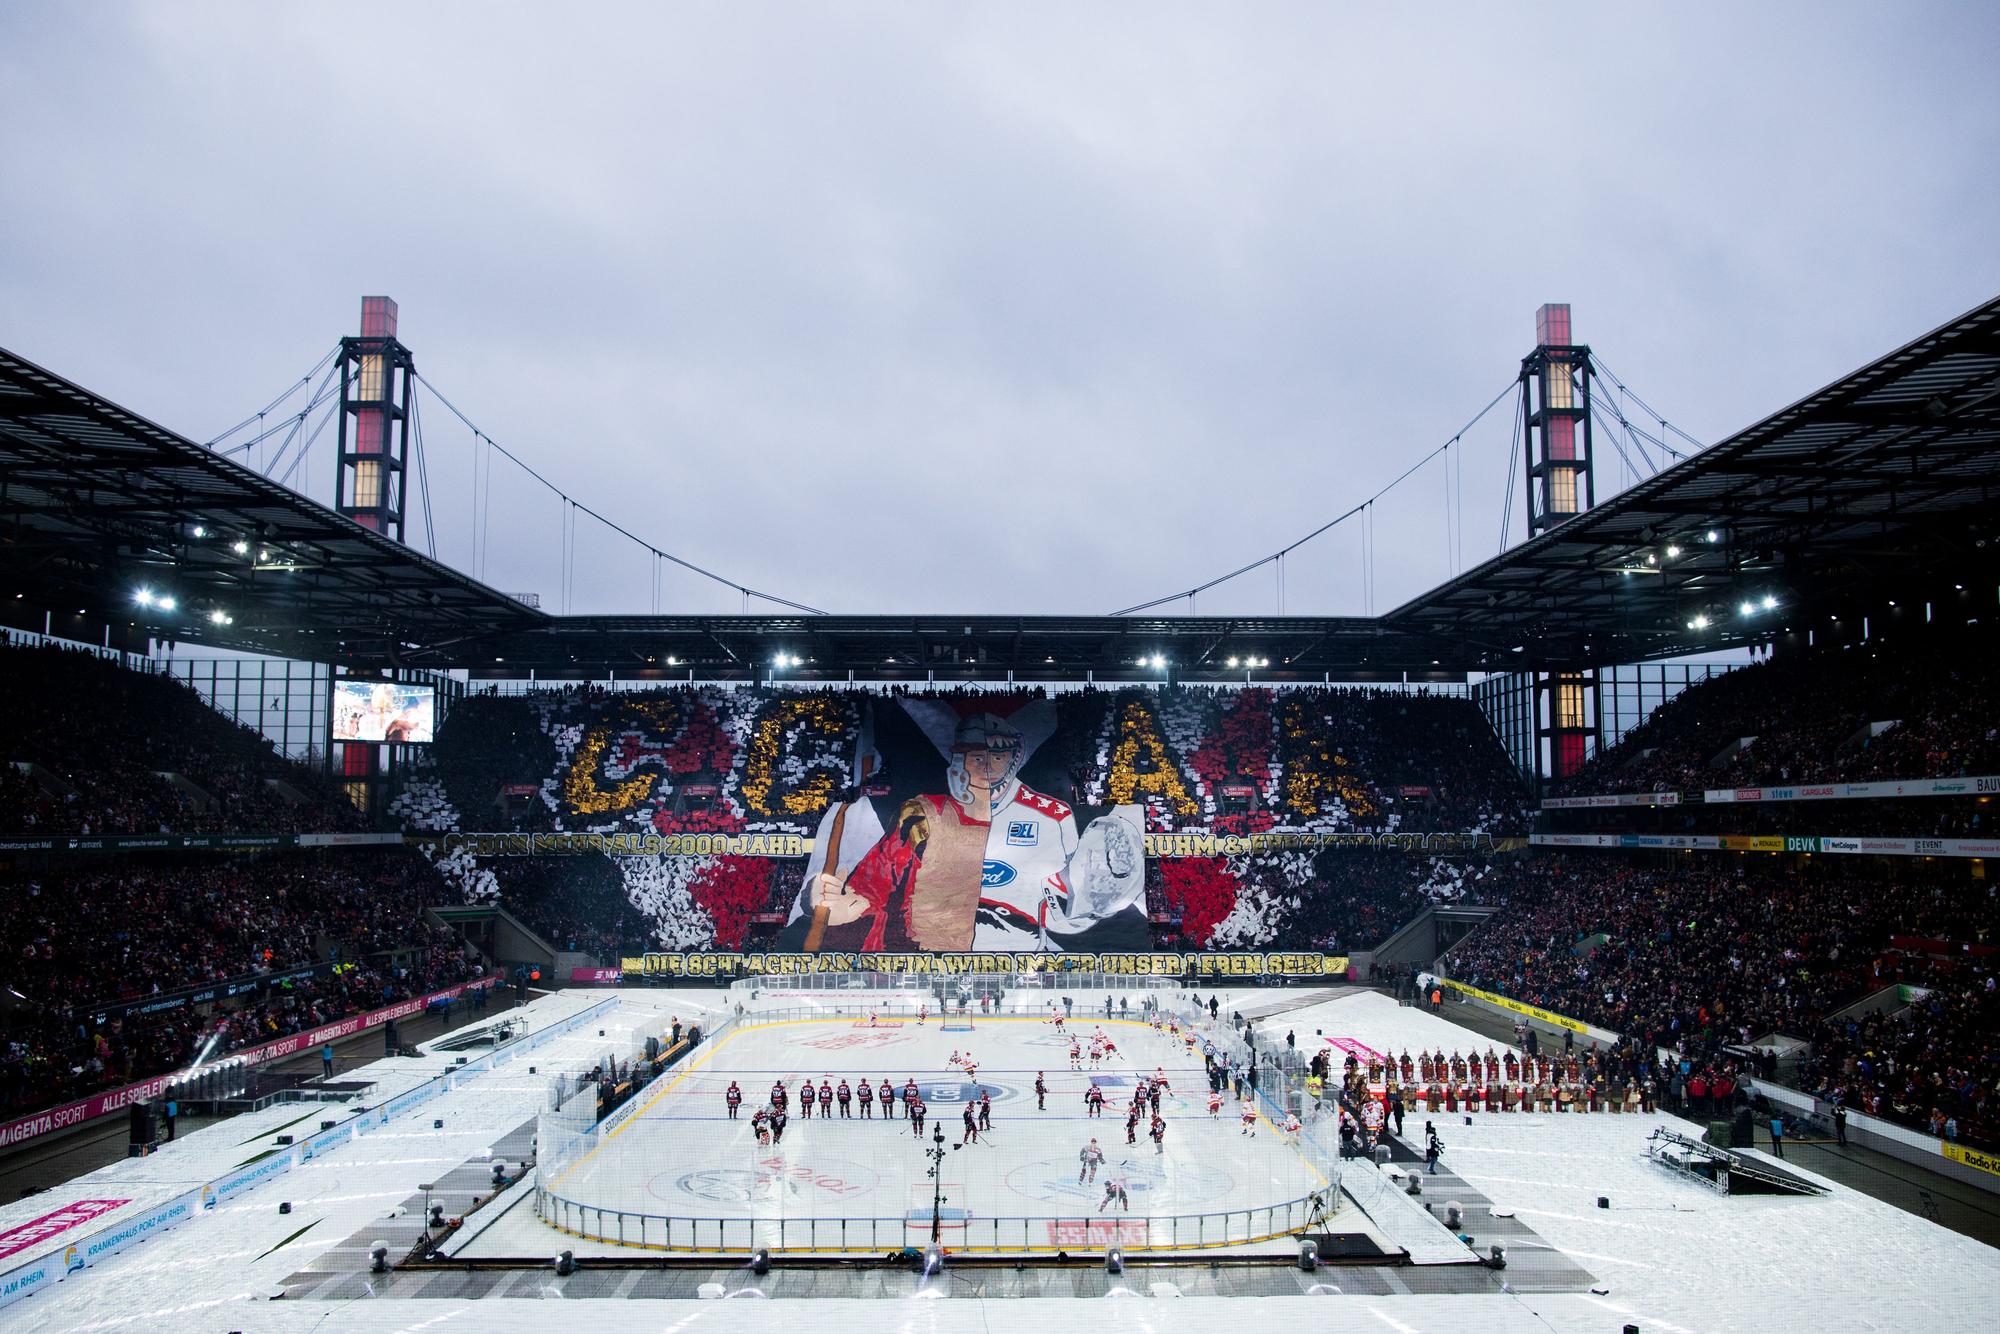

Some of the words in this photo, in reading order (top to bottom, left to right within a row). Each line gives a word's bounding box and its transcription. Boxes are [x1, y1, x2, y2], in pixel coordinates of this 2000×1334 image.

[612, 834, 661, 856] ALS
[665, 834, 728, 856] 2000
[732, 834, 803, 856] JAHR
[1145, 834, 1217, 856] RUHM
[1224, 834, 1244, 856] &
[1788, 838, 1816, 852] DEVK
[1831, 841, 1858, 850] NetCologne
[1922, 840, 1942, 848] EVENT
[644, 954, 684, 976] DIE
[818, 954, 857, 972] AM
[944, 954, 1012, 974] WIRD
[1017, 954, 1096, 974] IMMER
[1101, 954, 1182, 975] UNSER
[1266, 954, 1324, 975] SEIN
[366, 1014, 378, 1028] ALLE
[378, 1008, 394, 1023] SPIELE
[315, 1025, 341, 1044] MAGENTA
[342, 1020, 358, 1035] SPORT
[244, 1046, 278, 1066] MAGTA
[278, 1038, 298, 1056] SPORT
[102, 1092, 126, 1113] ALLE
[128, 1080, 158, 1103] SPIELE
[0, 1116, 52, 1146] MAGENTA
[54, 1104, 88, 1129] SPORT
[1965, 1152, 1989, 1169] Radio
[219, 1172, 256, 1195] KRANKENHAUS
[256, 1164, 270, 1178] PORZ
[88, 1224, 138, 1256] KRANKENHAUS
[139, 1218, 156, 1233] PORZ
[157, 1212, 168, 1224] AM
[168, 1204, 187, 1218] RHEIN
[4, 1278, 18, 1296] AM
[20, 1268, 45, 1287] RHEIN
